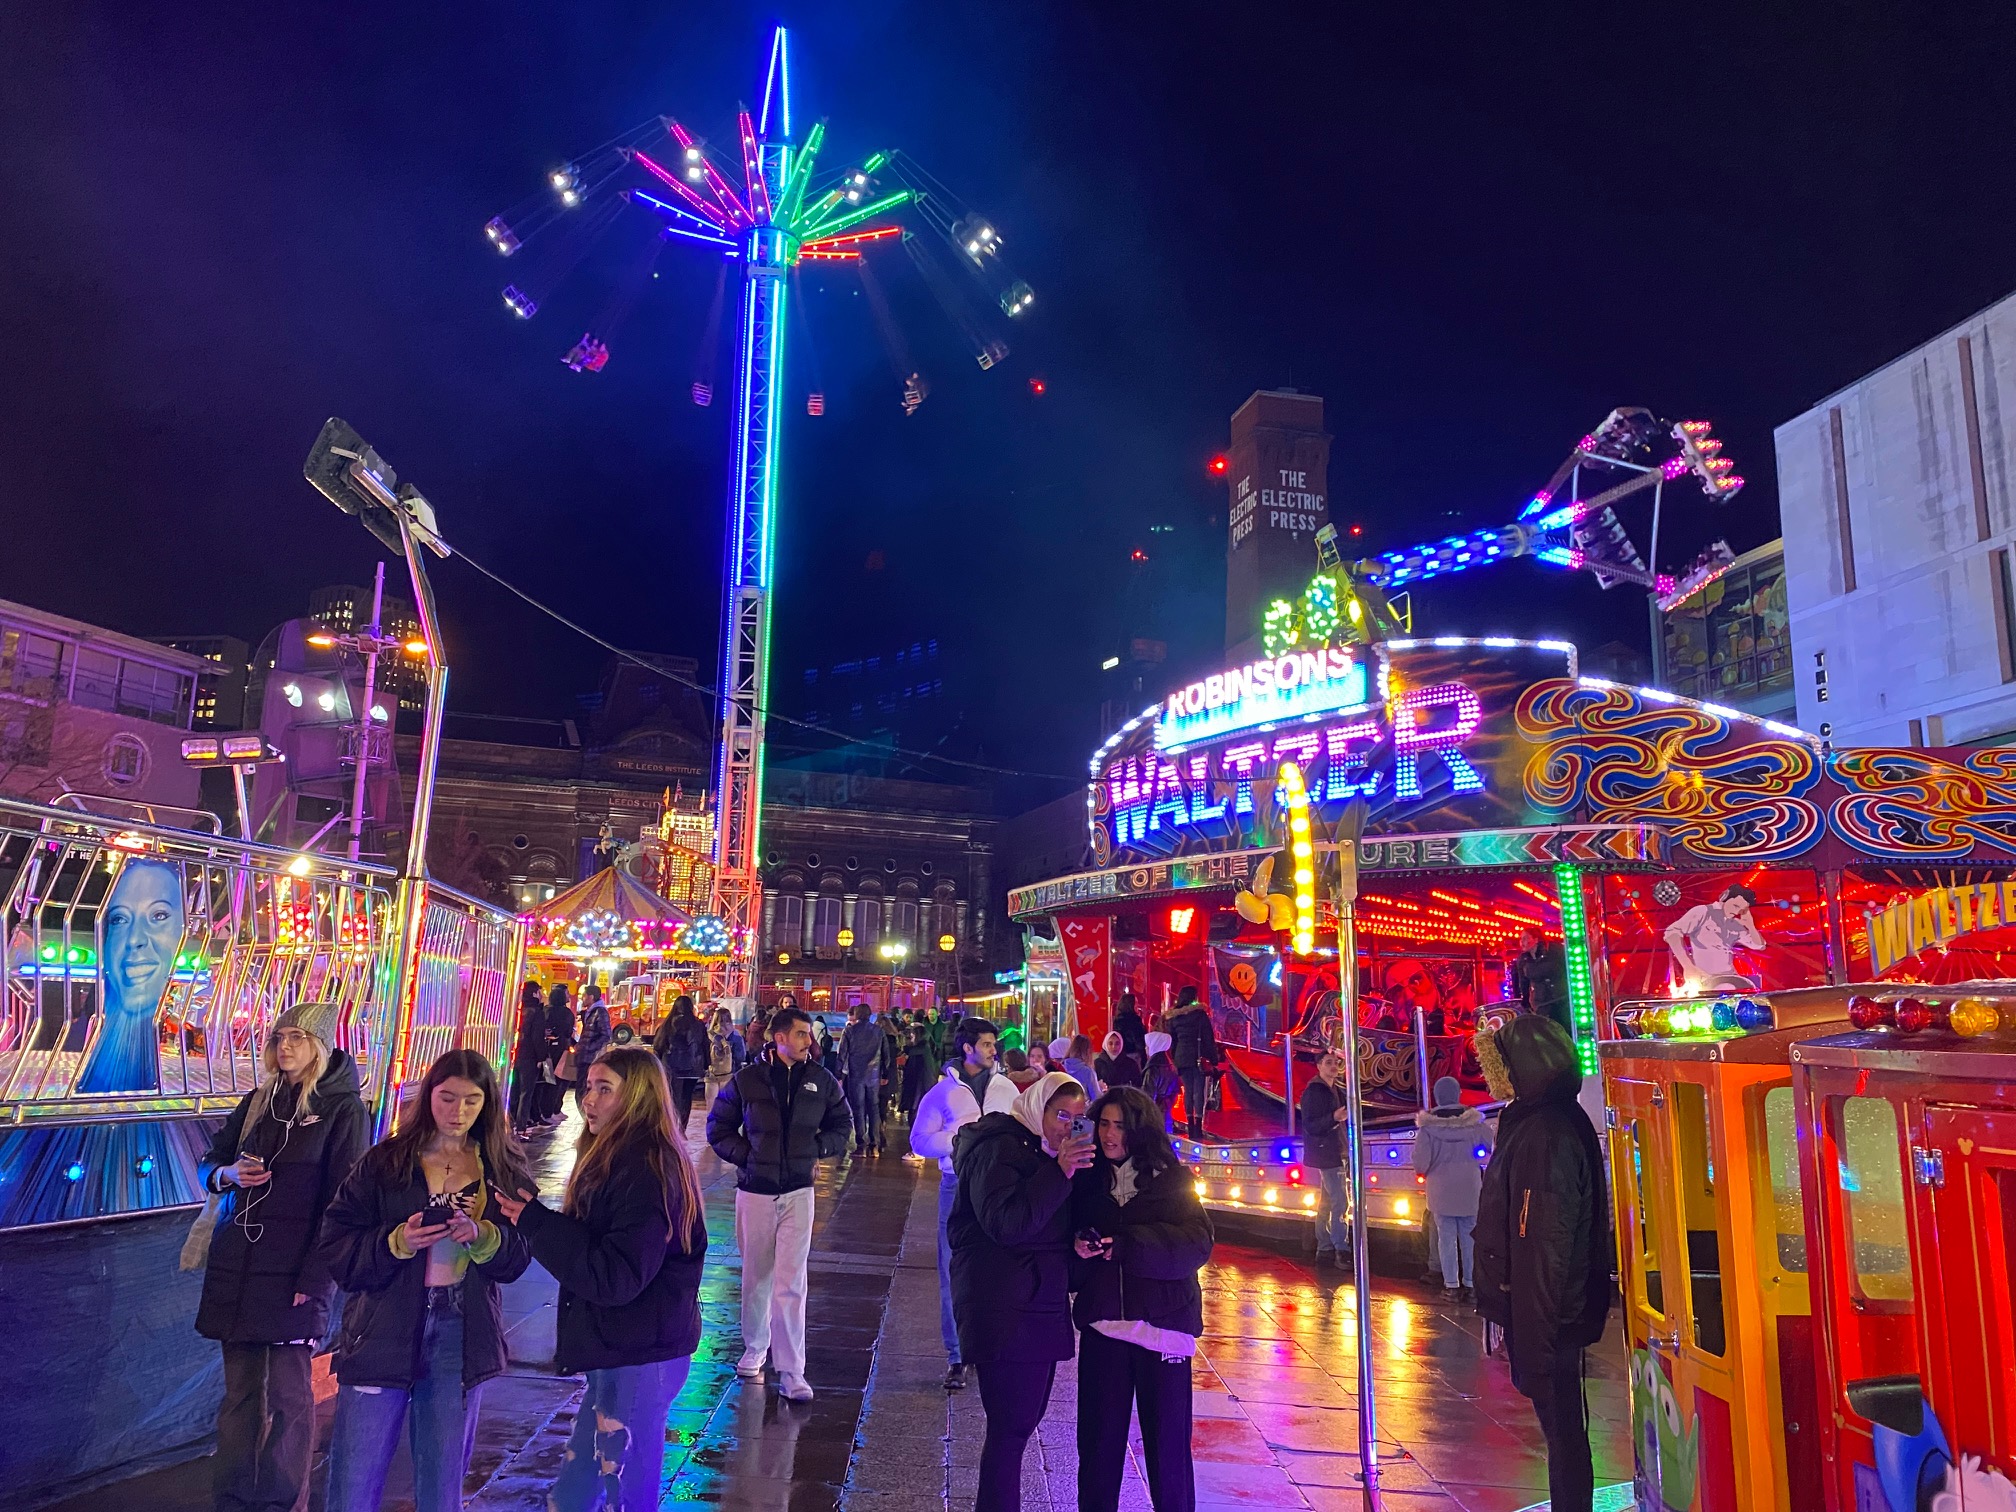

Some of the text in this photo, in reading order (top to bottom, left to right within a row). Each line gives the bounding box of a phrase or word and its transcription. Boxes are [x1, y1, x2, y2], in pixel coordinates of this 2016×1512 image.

[1237, 475, 1250, 499] THE
[1279, 469, 1307, 488] THE
[1230, 490, 1257, 526] ELECTRIC
[1261, 488, 1325, 512] ELECTRIC
[1232, 514, 1254, 544] PRESS
[1270, 510, 1316, 531] PRESS
[1814, 652, 1828, 702] THE
[617, 761, 702, 775] THE LEEDS INSTITUTE
[1110, 680, 1487, 844] WALTZER
[609, 798, 640, 807] LEEDS
[1037, 873, 1117, 906] WALTZER
[1131, 864, 1168, 892] OF
[1188, 855, 1250, 879] THE
